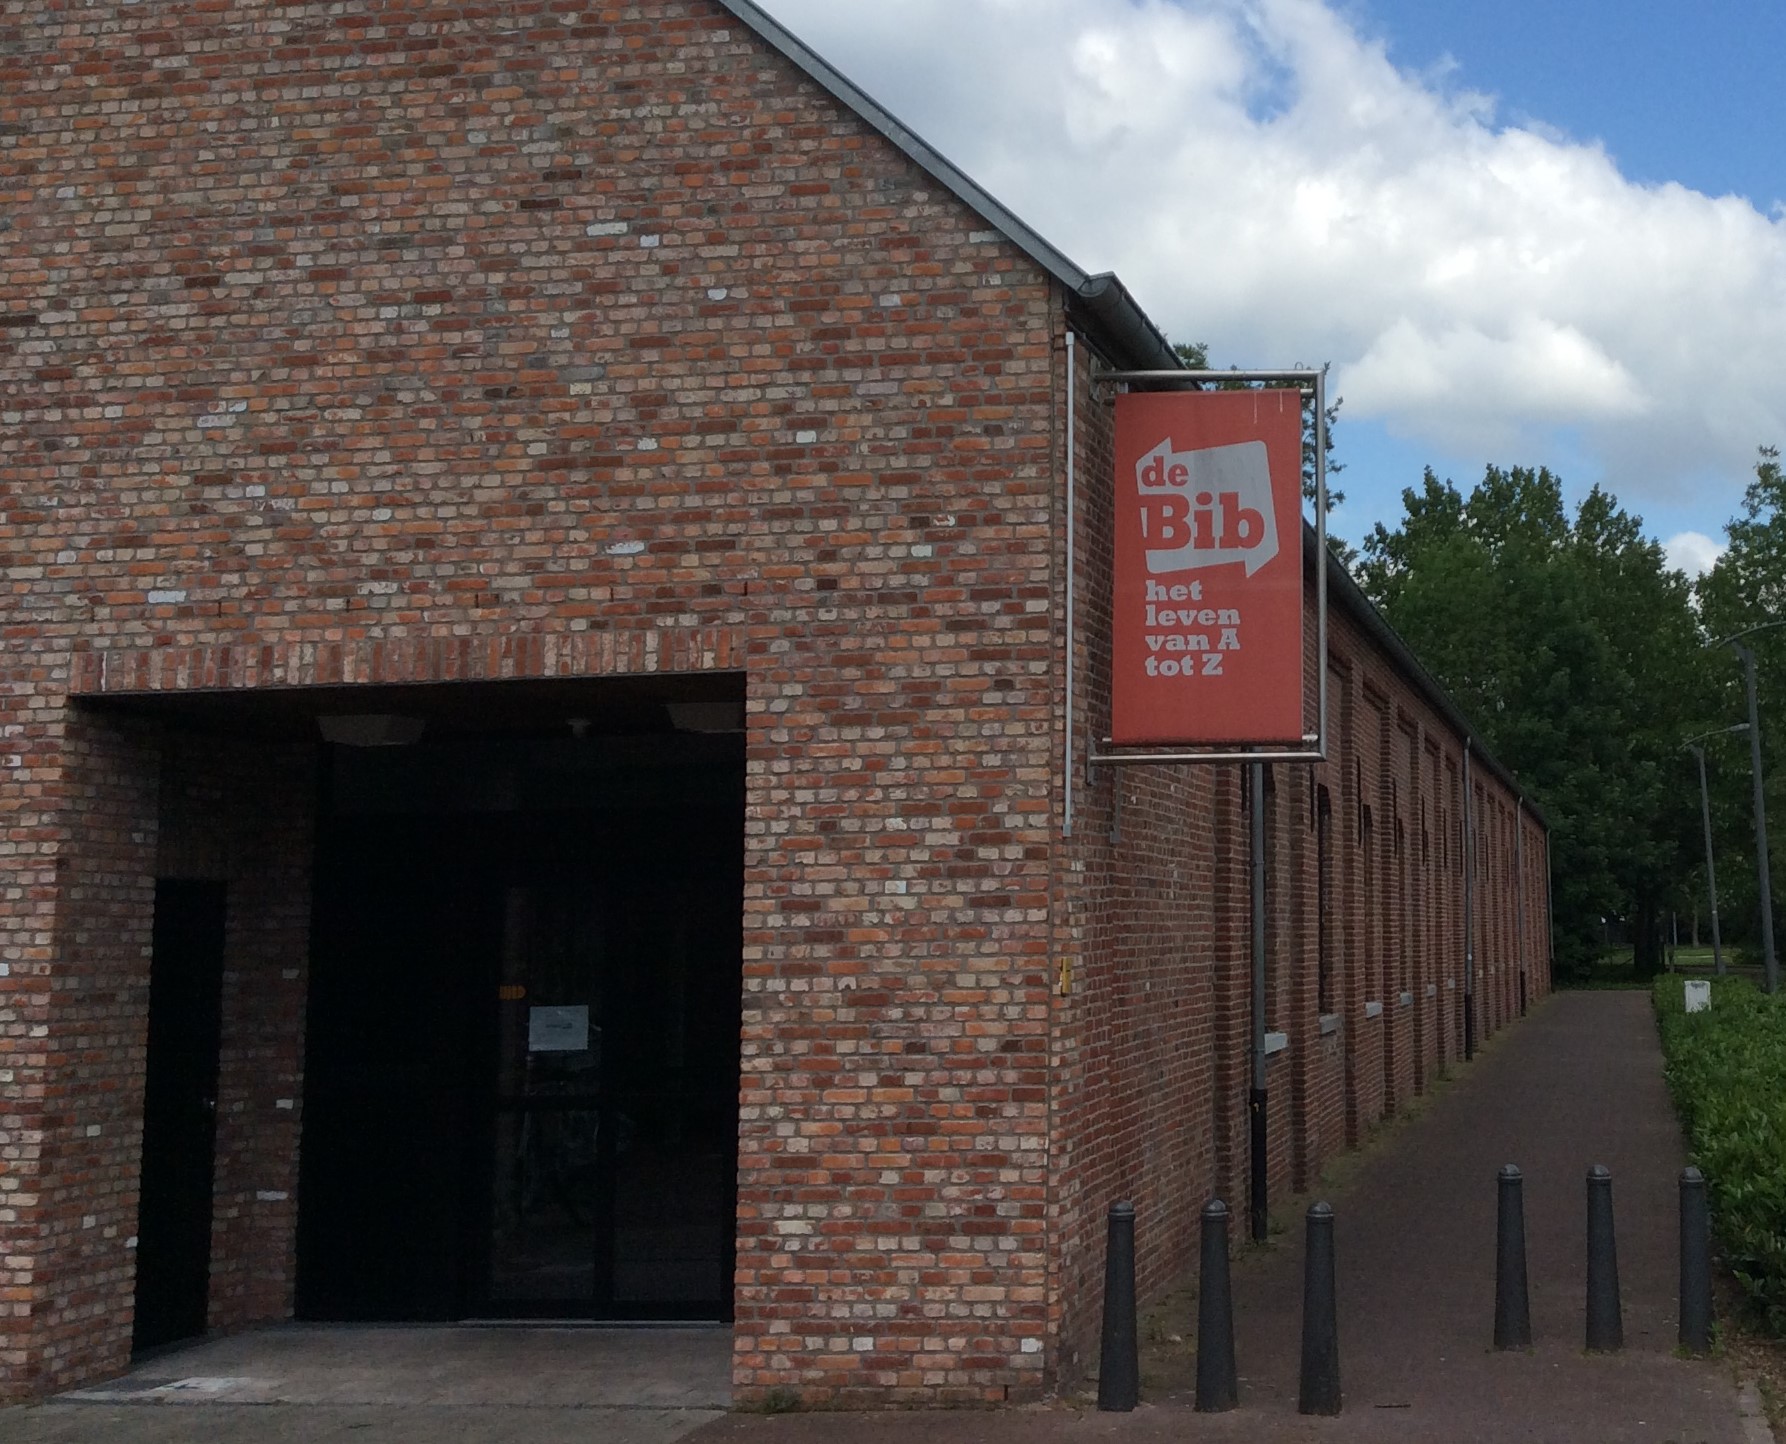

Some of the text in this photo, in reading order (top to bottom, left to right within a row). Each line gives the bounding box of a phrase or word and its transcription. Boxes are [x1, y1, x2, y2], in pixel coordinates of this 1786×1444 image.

[1141, 456, 1189, 487] de
[1144, 492, 1265, 550] Bib
[1145, 580, 1202, 601] het
[1145, 605, 1240, 626] leven
[1145, 628, 1240, 651] van A
[1145, 653, 1223, 676] tot Z
